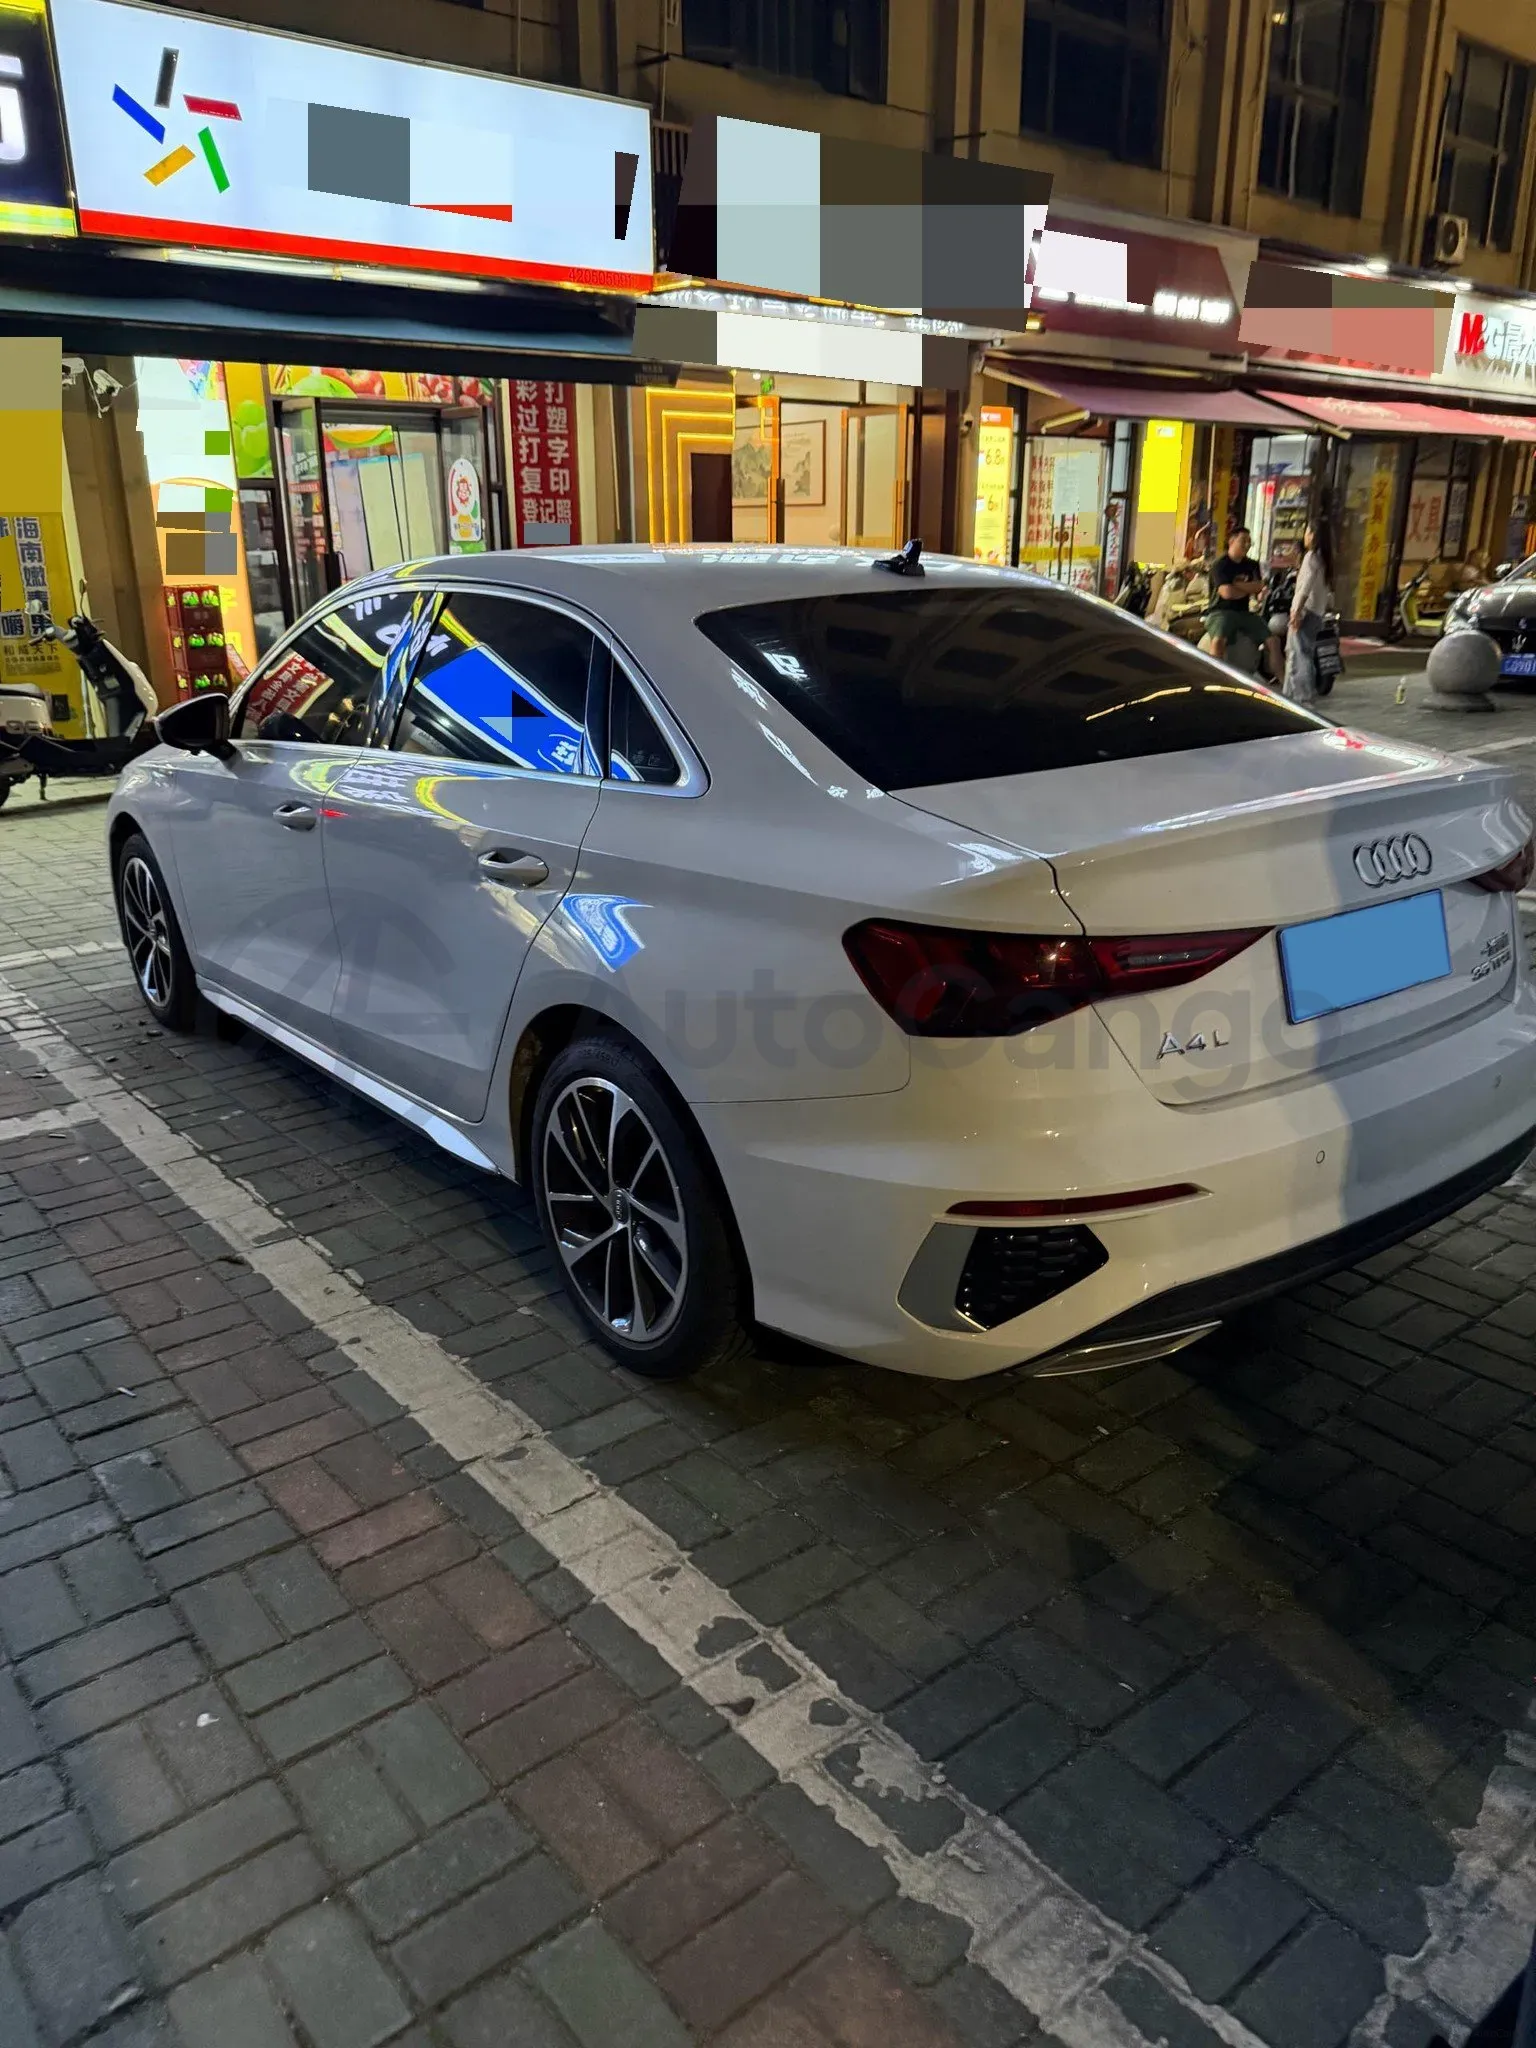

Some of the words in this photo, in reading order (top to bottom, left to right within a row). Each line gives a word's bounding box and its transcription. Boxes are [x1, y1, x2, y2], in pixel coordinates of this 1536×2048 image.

[517, 405, 569, 434] 过塑
[518, 436, 570, 464] 打字
[520, 466, 571, 495] 复印
[522, 498, 572, 524] 登记照
